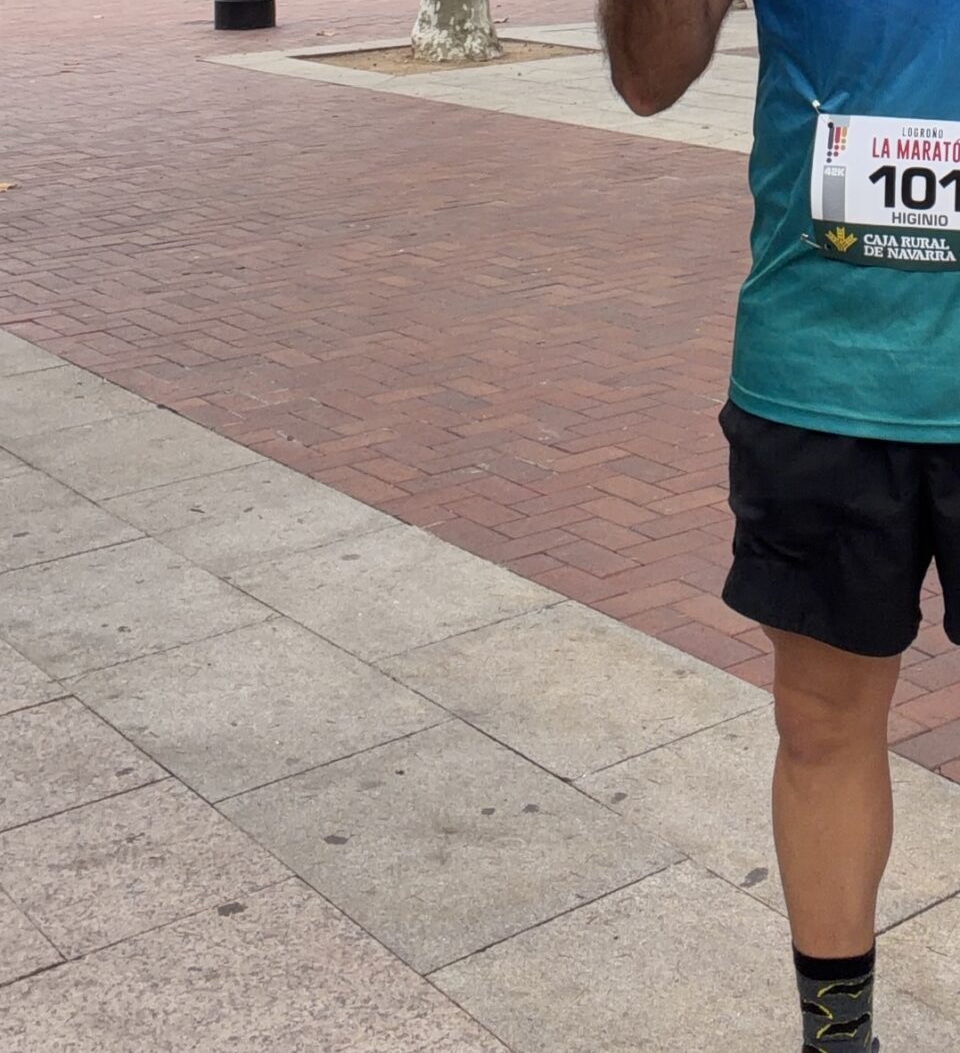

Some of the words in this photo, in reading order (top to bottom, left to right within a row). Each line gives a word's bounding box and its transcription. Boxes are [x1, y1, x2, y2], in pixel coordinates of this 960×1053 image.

[901, 127, 944, 139] LOGROÑO
[872, 137, 890, 159] LA
[824, 166, 846, 178] 42K
[891, 212, 949, 227] HIGINIO
[863, 233, 899, 248] CAJA
[900, 236, 950, 250] RURAL
[863, 247, 883, 259] DE
[887, 248, 957, 262] NAVARRA
